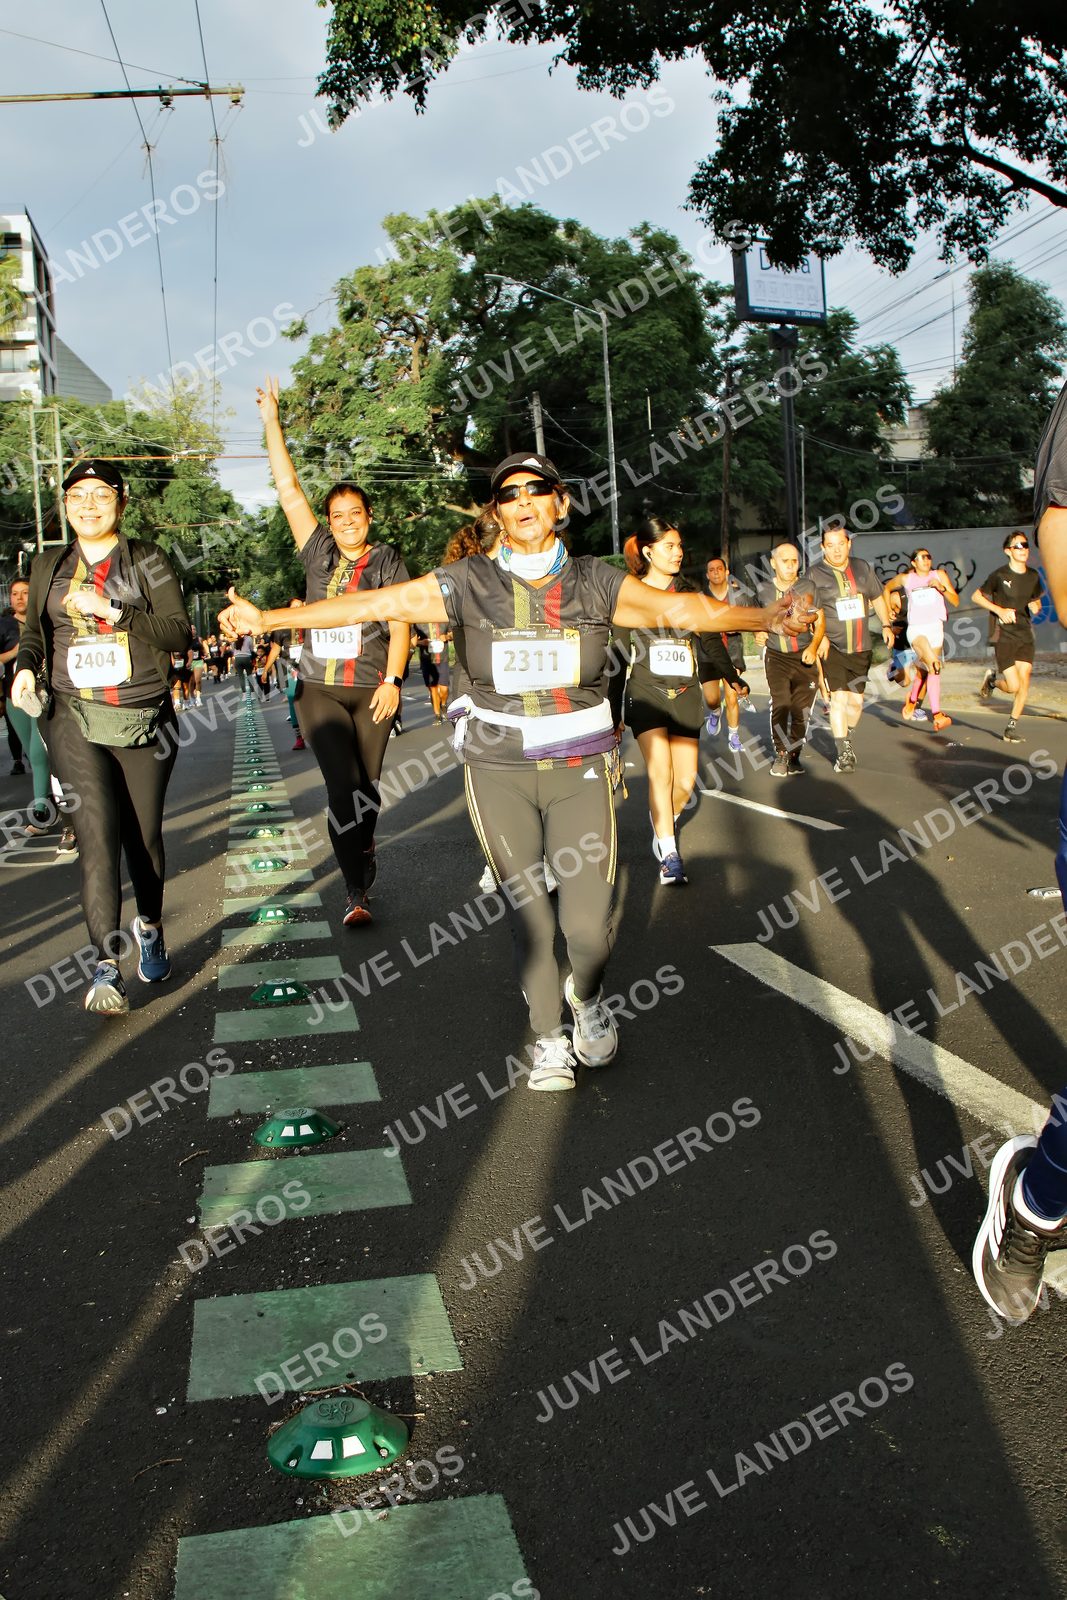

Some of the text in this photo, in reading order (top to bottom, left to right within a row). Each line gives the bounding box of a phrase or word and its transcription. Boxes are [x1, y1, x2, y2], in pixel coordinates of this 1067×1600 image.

[314, 630, 353, 644] 11903
[74, 650, 116, 669] 2404
[503, 650, 558, 672] 2311
[657, 649, 686, 663] 5206
